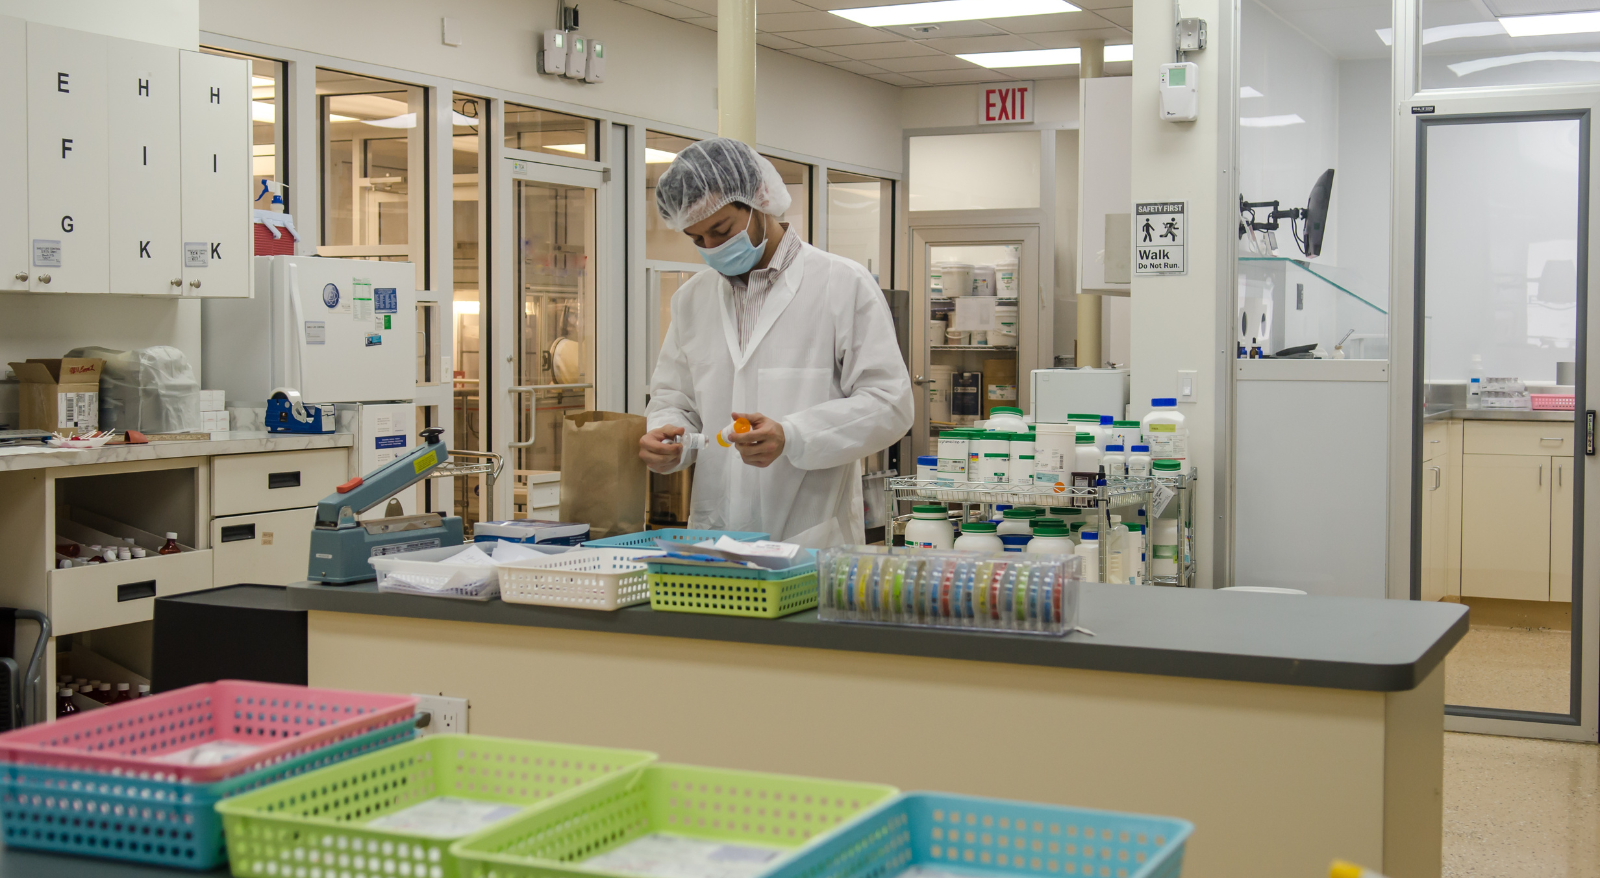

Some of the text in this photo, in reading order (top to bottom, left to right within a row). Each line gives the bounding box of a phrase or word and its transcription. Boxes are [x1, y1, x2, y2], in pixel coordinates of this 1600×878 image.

[57, 72, 70, 94] E
[138, 78, 149, 97] H
[210, 87, 220, 105] H
[985, 87, 1028, 122] EXIT
[62, 138, 74, 159] F
[143, 146, 147, 166] I
[213, 154, 217, 173] I
[1138, 204, 1182, 213] SAFETY FIRST
[61, 215, 74, 233] G
[139, 241, 152, 259] K
[210, 242, 222, 260] K
[1138, 249, 1170, 261] Walk
[1138, 262, 1148, 270] Do
